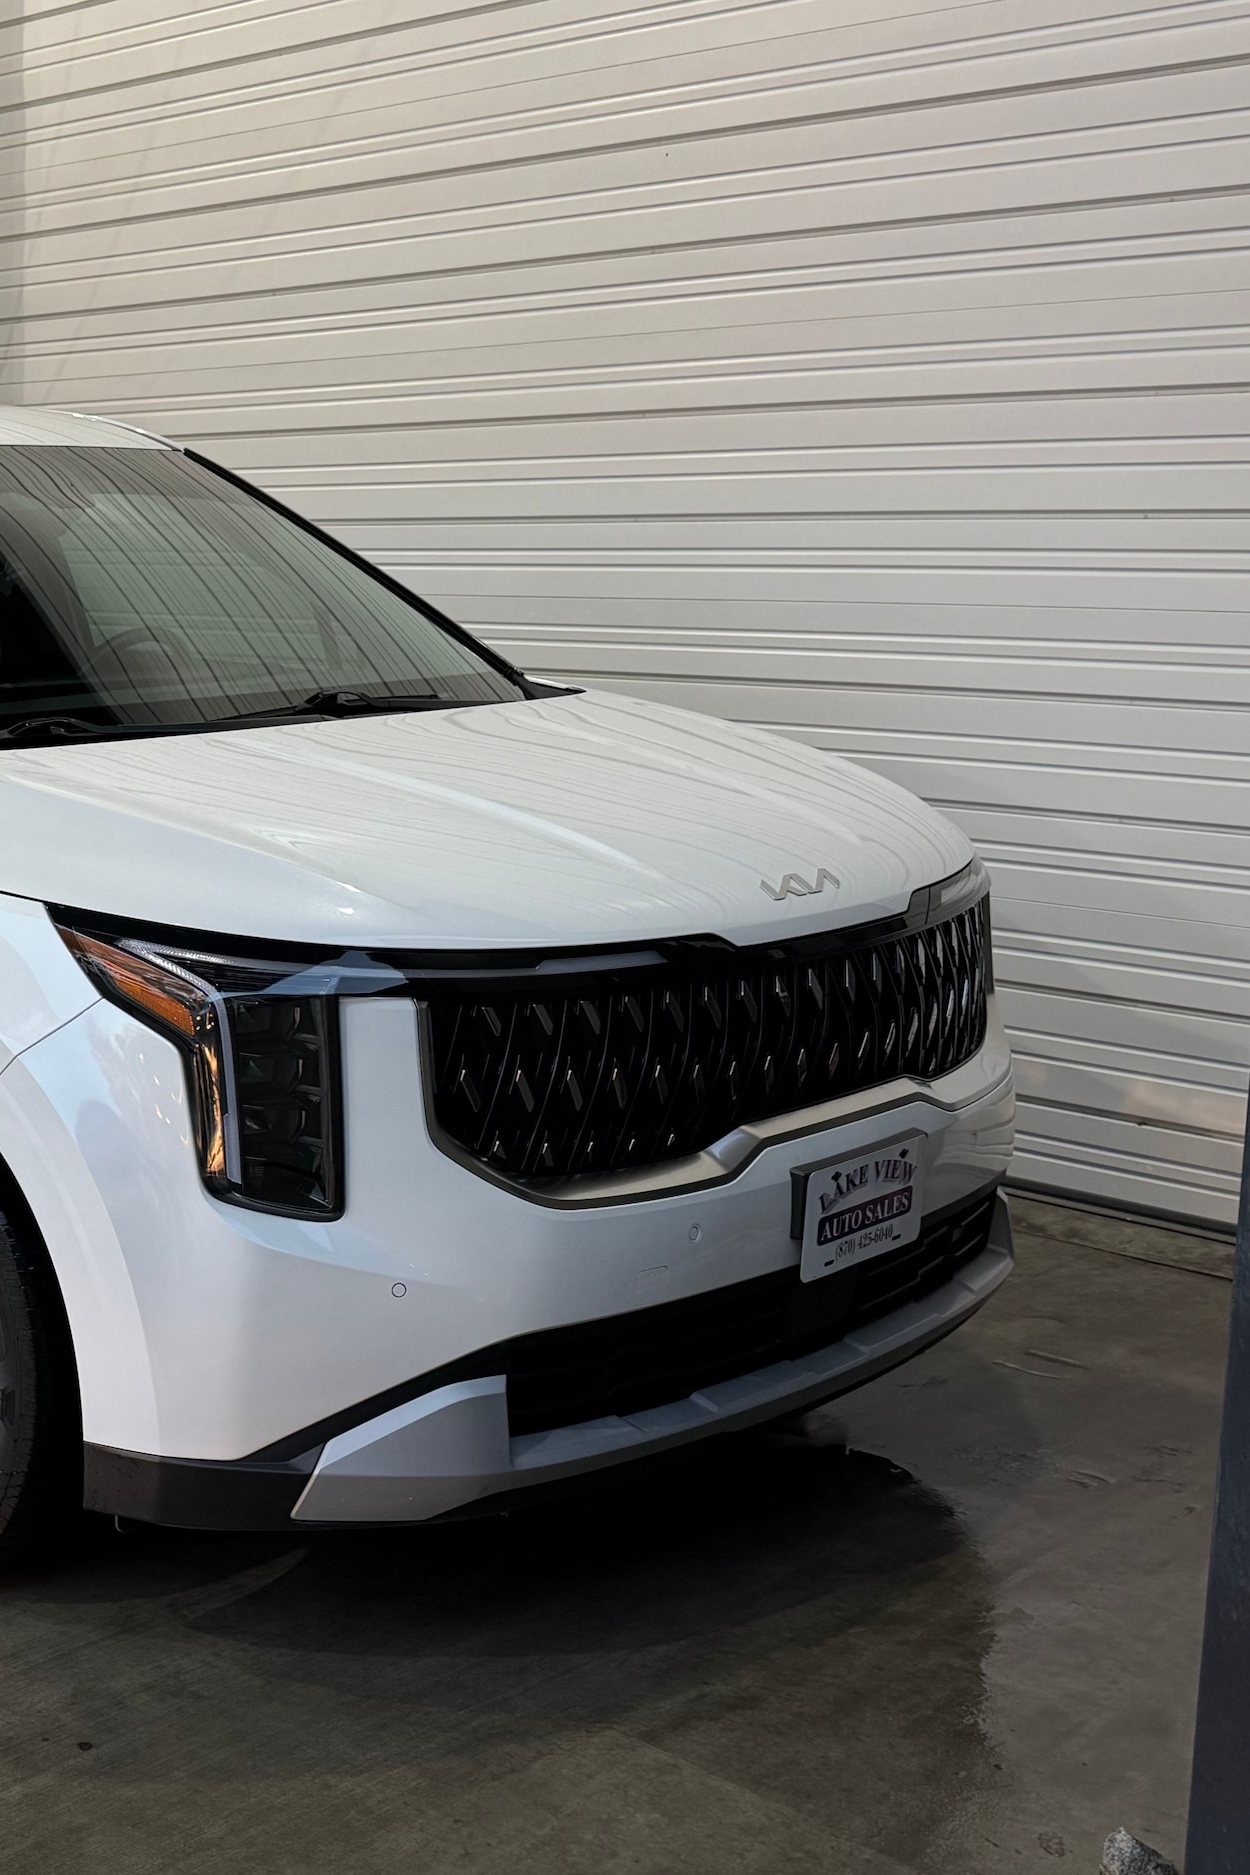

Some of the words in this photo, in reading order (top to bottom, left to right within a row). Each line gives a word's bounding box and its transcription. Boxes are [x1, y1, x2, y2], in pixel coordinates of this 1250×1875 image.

[819, 1164, 869, 1213] LAKE
[874, 1158, 918, 1186] VIEW
[821, 1209, 863, 1242] AUTO
[864, 1192, 909, 1224] SALES
[835, 1240, 855, 1261] (870)
